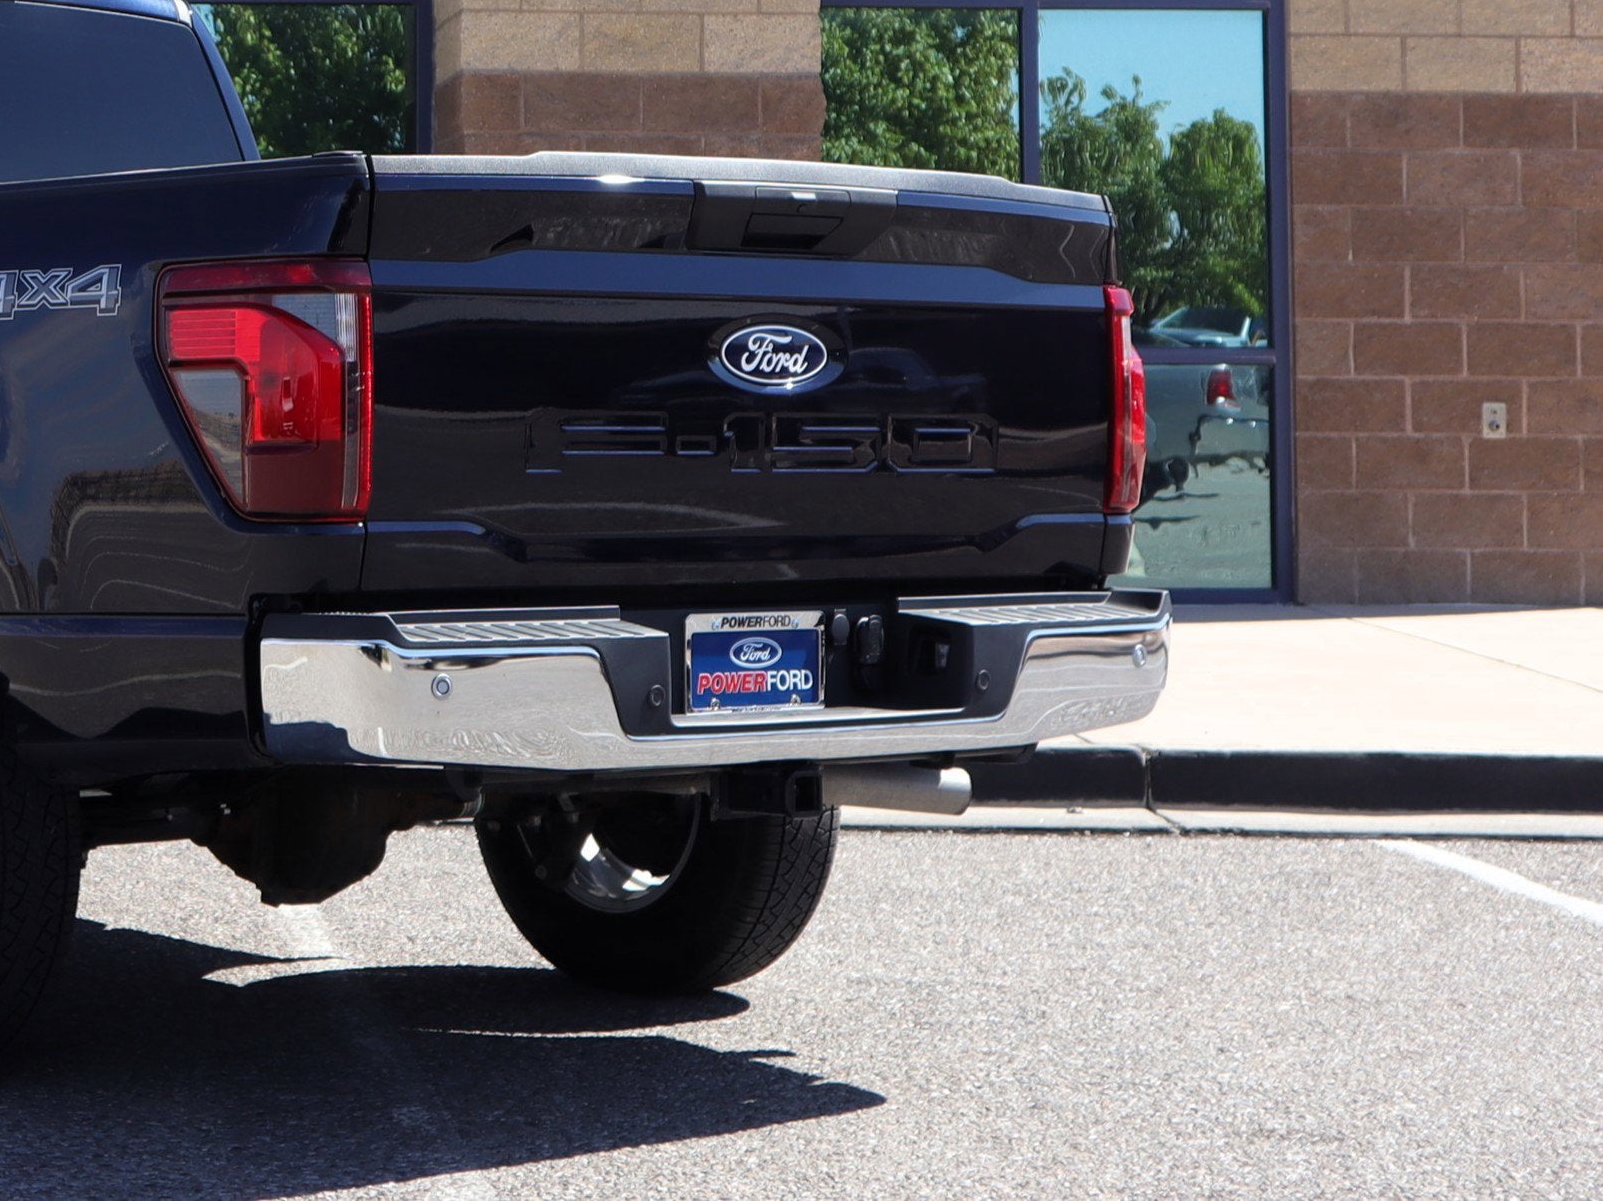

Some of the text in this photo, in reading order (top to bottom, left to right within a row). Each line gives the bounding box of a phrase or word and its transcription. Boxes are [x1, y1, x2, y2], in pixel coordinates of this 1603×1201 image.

[740, 332, 809, 376] Ford
[525, 408, 998, 473] F-150
[720, 615, 791, 629] POWERFORD
[739, 643, 771, 661] Ford
[698, 670, 814, 695] POWERFORD
